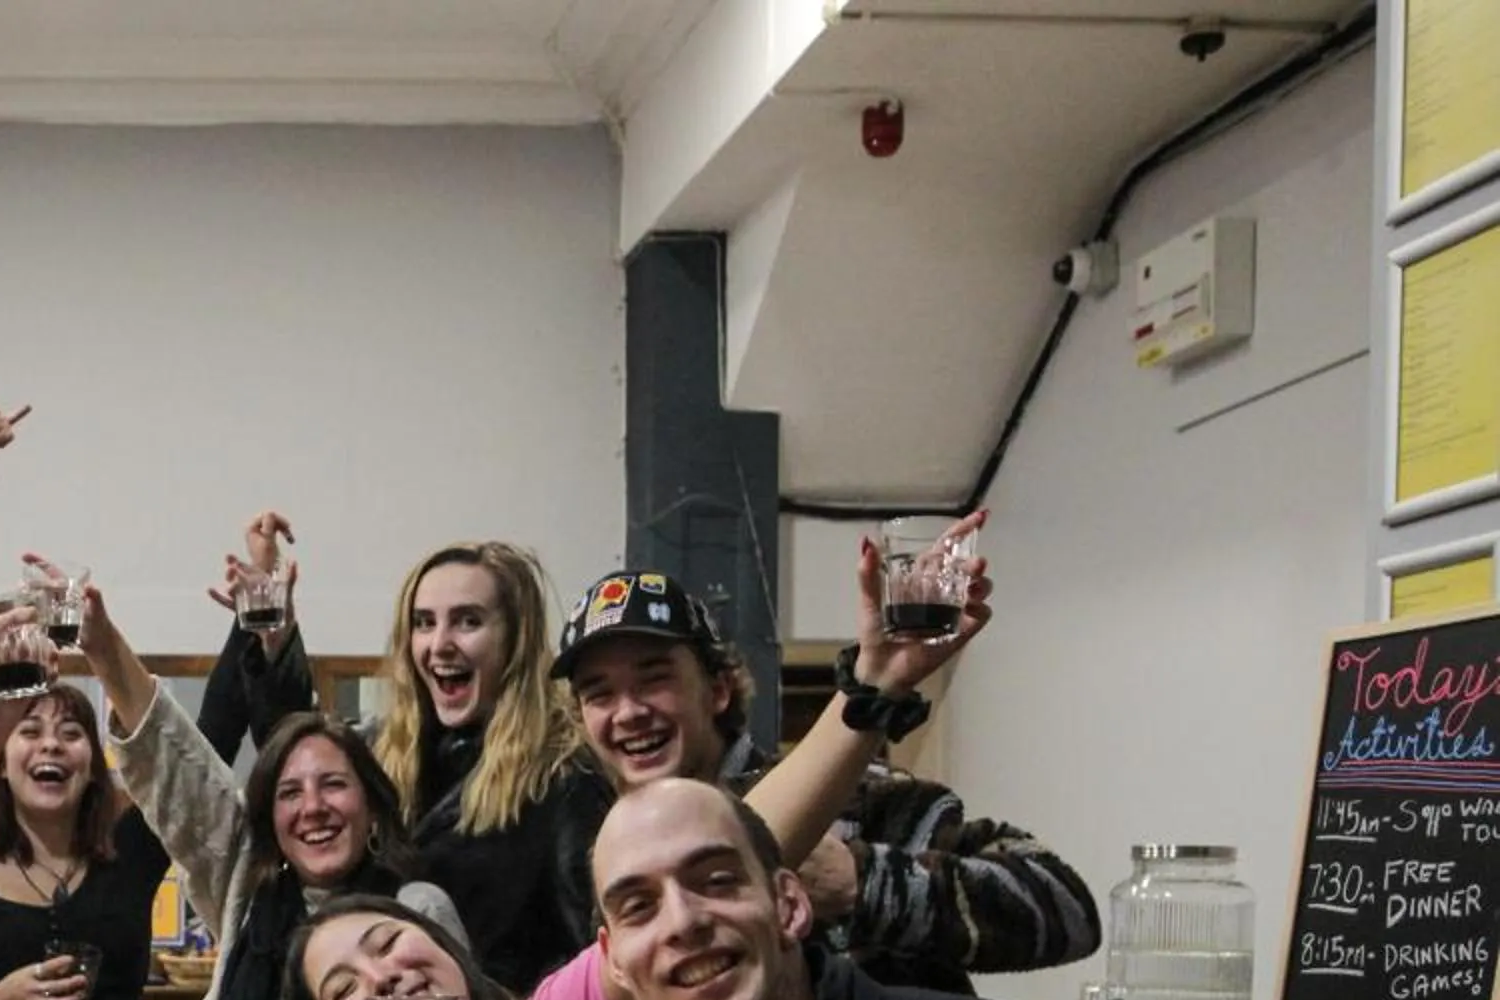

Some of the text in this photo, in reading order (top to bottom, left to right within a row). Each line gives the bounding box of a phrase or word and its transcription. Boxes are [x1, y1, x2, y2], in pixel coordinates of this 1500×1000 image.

[1323, 706, 1495, 770] Activities
[1383, 860, 1456, 891] FREE
[1386, 884, 1481, 928] DINNER
[1384, 936, 1489, 972] DRINKING
